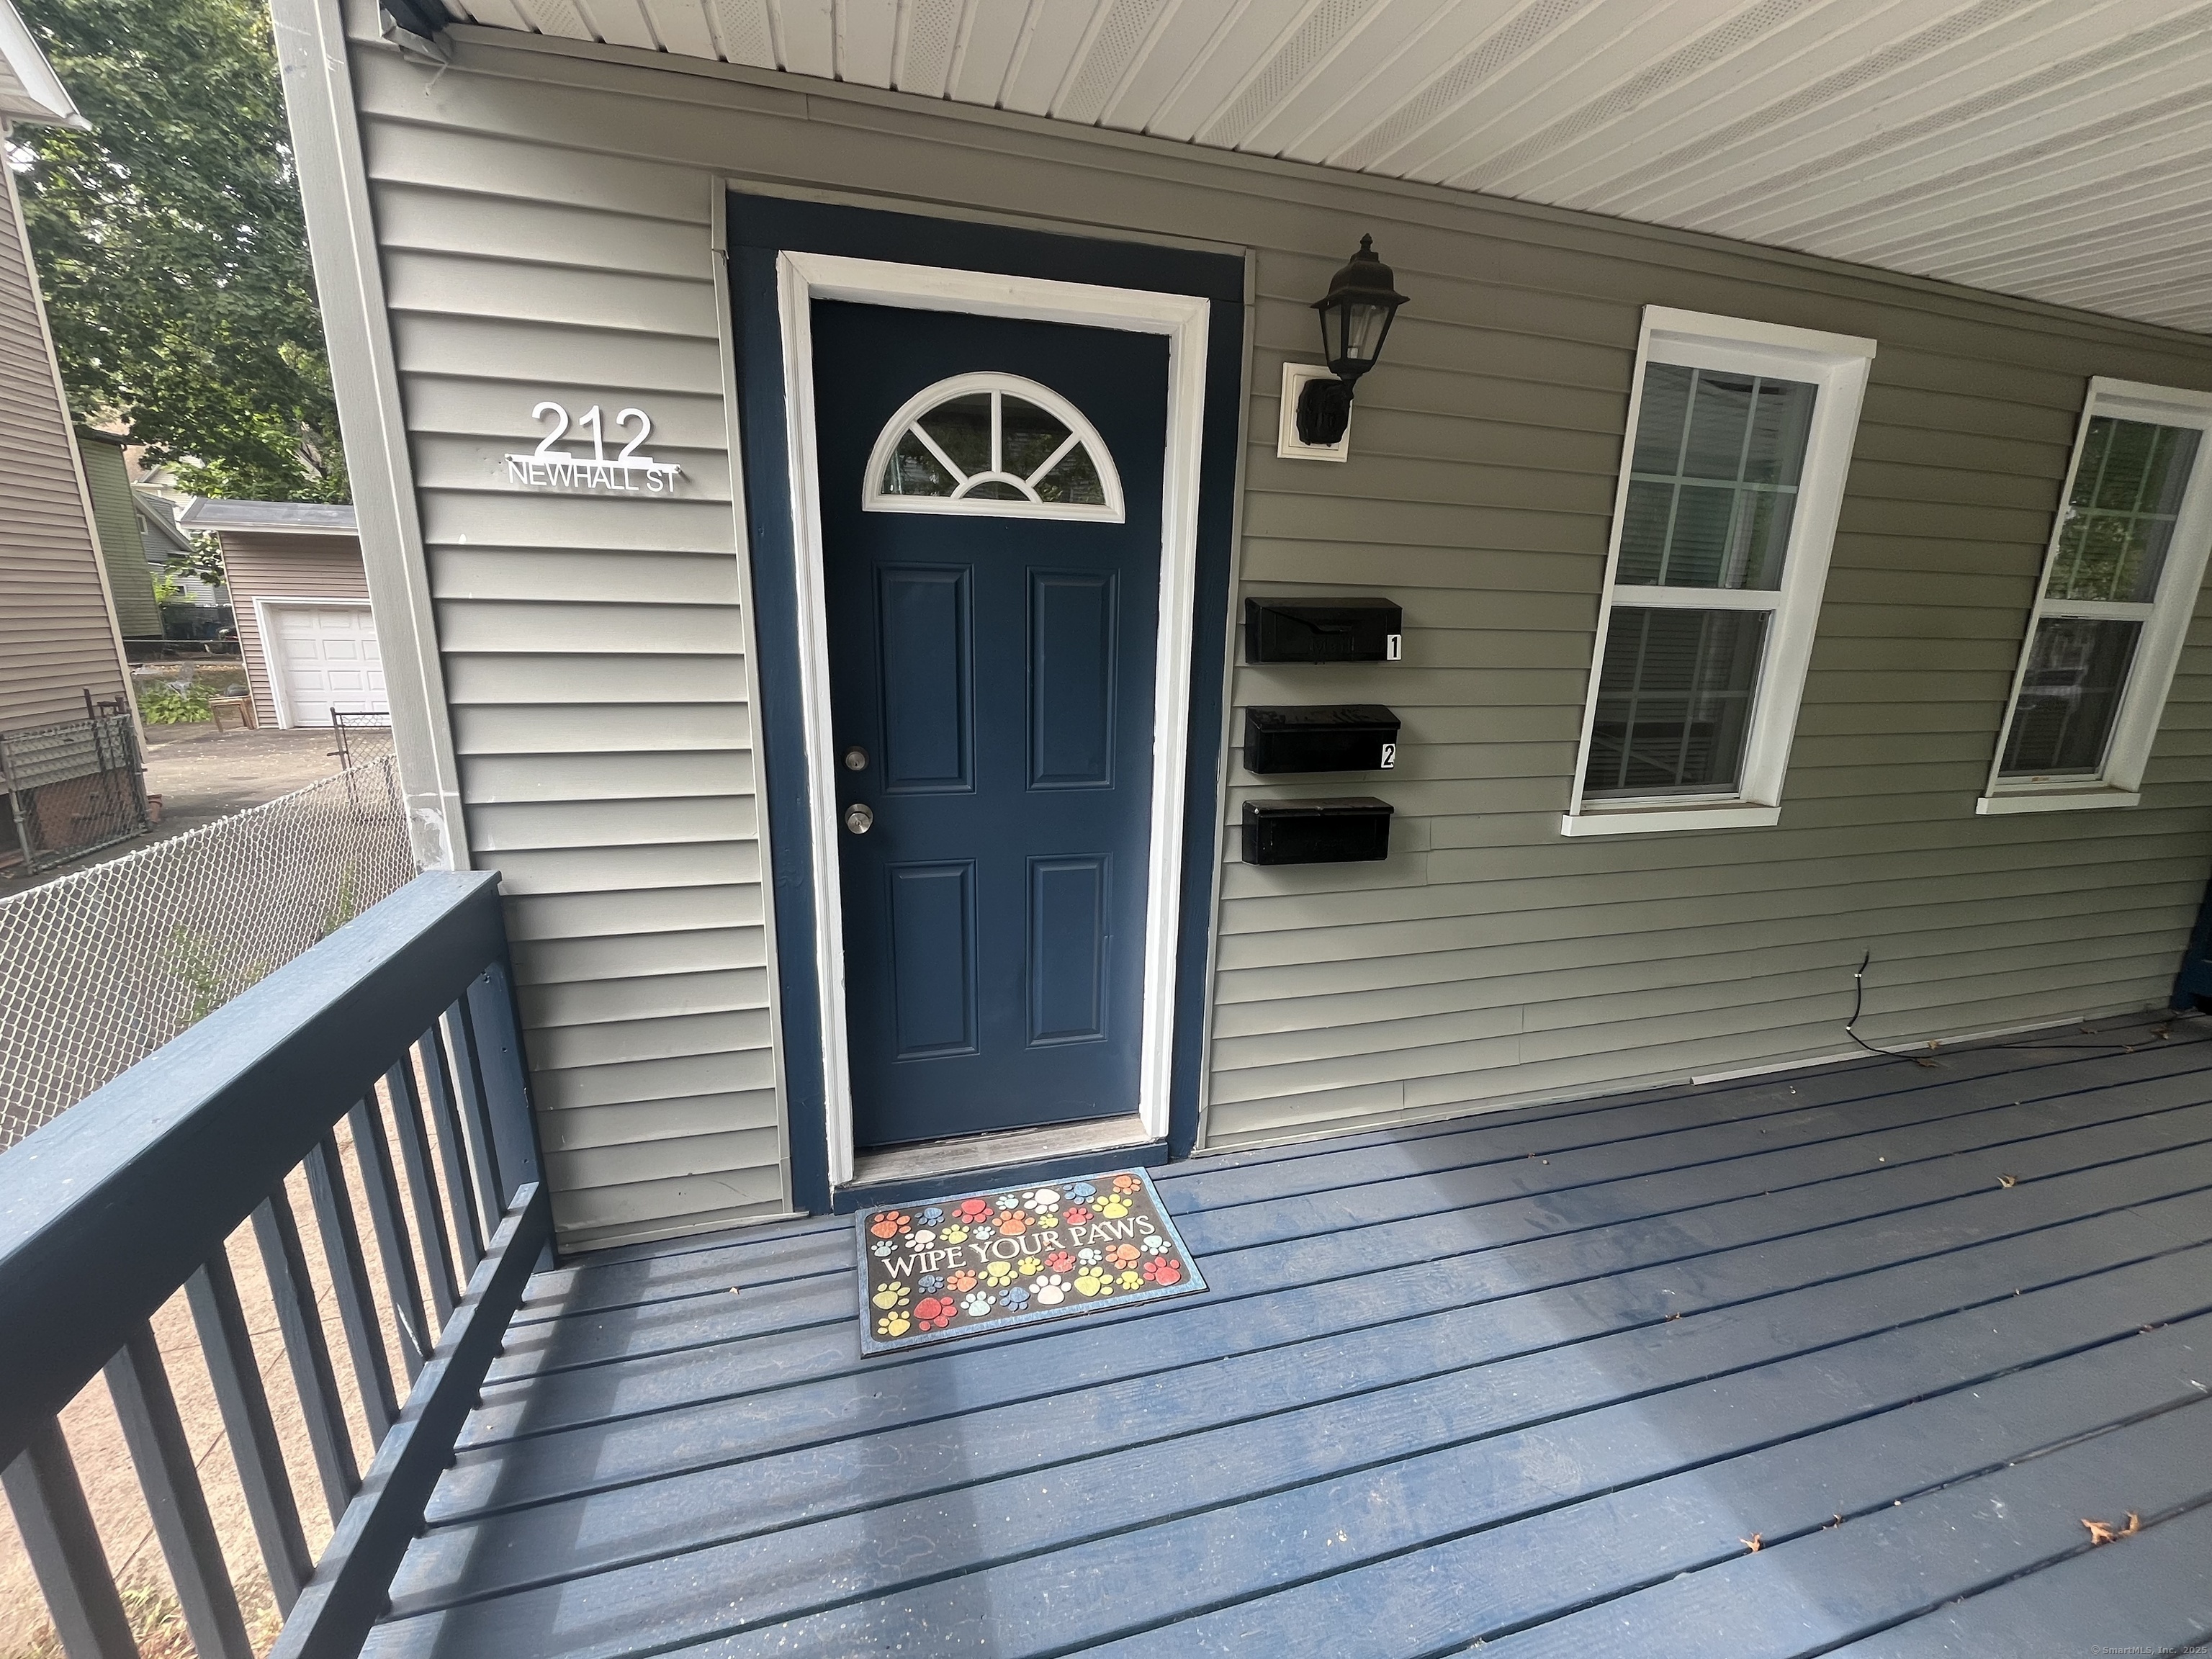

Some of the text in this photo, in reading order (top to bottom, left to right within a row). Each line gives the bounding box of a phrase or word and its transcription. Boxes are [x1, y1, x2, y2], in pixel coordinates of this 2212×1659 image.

[531, 401, 654, 464] 212
[507, 459, 680, 493] NEWHALL ST
[1391, 636, 1398, 658] 1
[1383, 745, 1395, 767] 2
[881, 1214, 1156, 1279] WIPE YOUR PAWS
